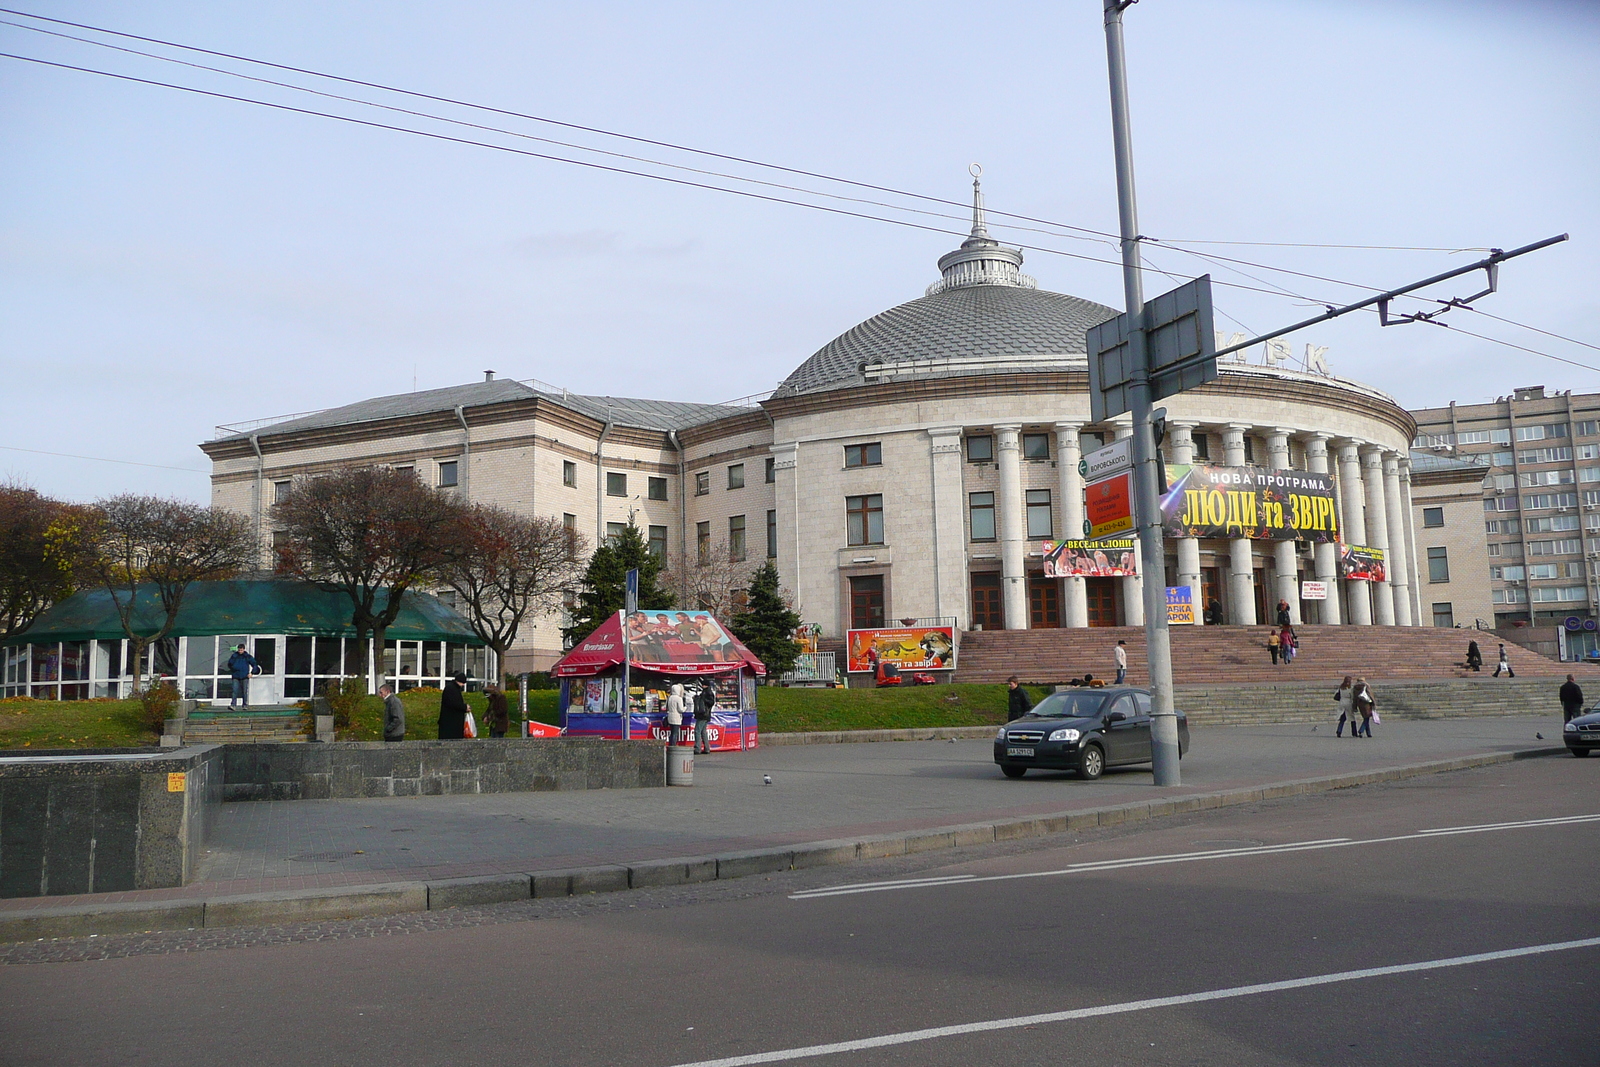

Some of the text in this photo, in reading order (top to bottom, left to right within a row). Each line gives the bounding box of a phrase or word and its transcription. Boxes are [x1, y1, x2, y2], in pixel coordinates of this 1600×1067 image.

[1090, 454, 1126, 473] ВОРОВСЬКОГО
[1210, 473, 1326, 491] НОВА ПРОГРАМА
[1182, 489, 1337, 534] ЛЮДИ та ЗВІРІ
[1167, 605, 1192, 613] АВКА
[1167, 613, 1190, 621] АРОК
